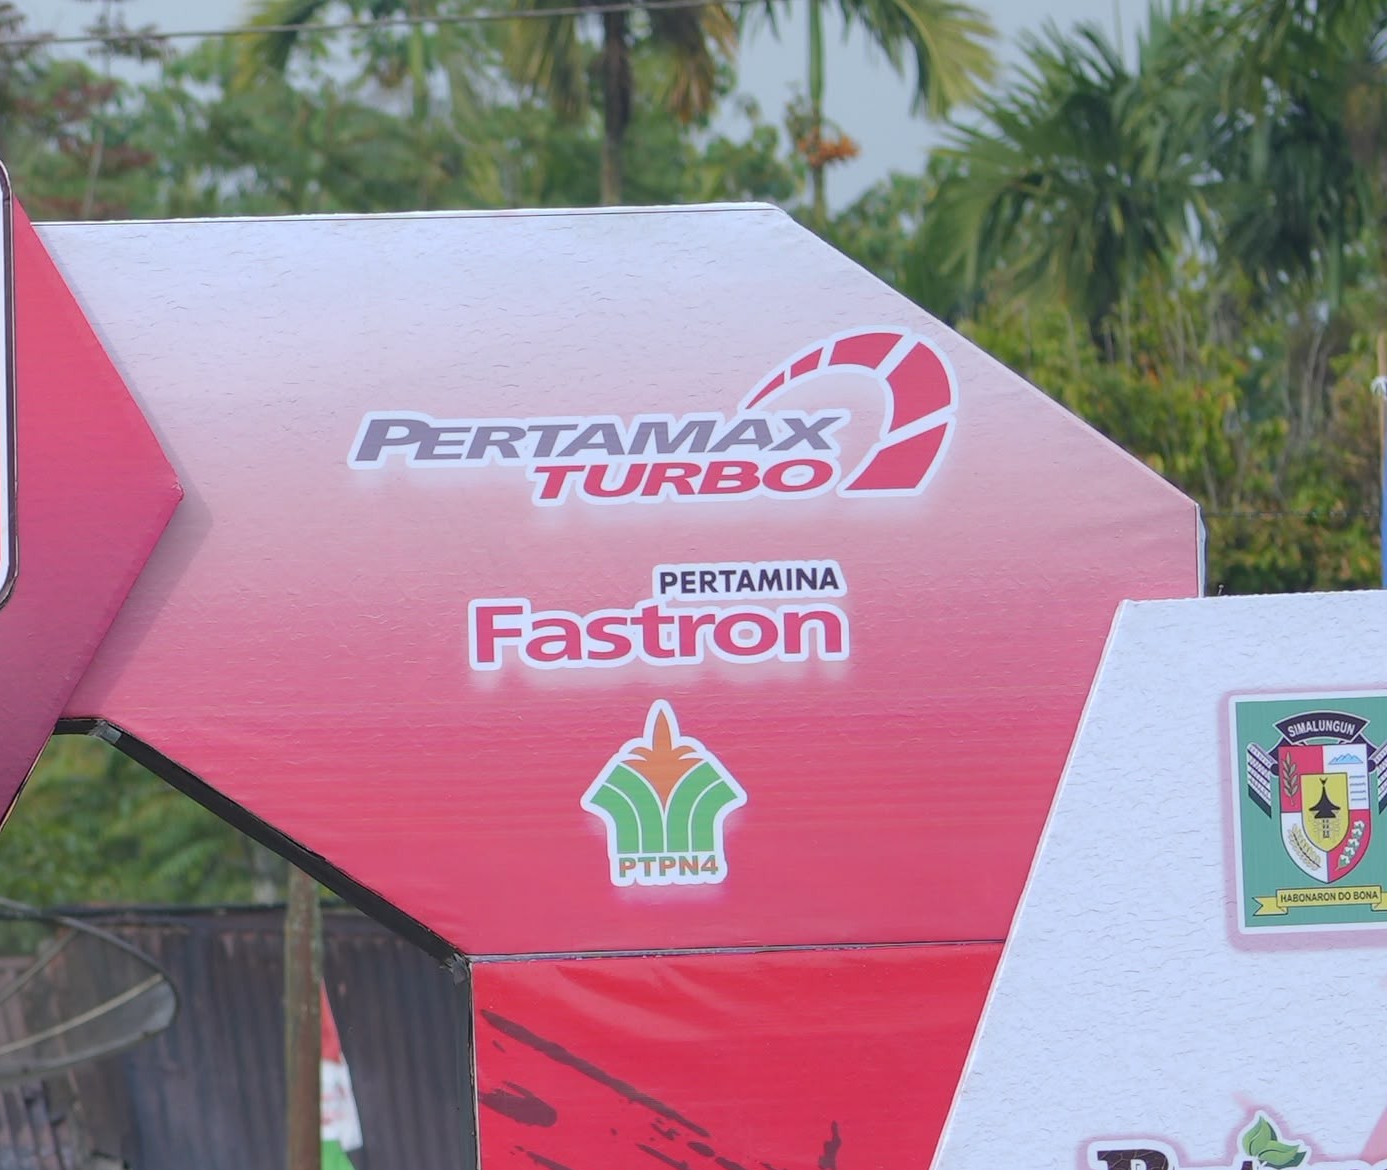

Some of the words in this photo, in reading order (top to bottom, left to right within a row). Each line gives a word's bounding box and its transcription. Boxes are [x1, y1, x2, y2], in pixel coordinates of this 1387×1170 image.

[355, 416, 843, 463] PERTAMAX
[531, 458, 834, 499] TURBO
[659, 565, 840, 596] PERTAMINA
[474, 603, 843, 664] Fastron
[1286, 719, 1356, 738] SIMALUNGUN
[618, 854, 719, 879] PTPN4
[1280, 890, 1337, 904] HABONARON
[1338, 889, 1352, 902] DO
[1353, 888, 1380, 901] BONA
